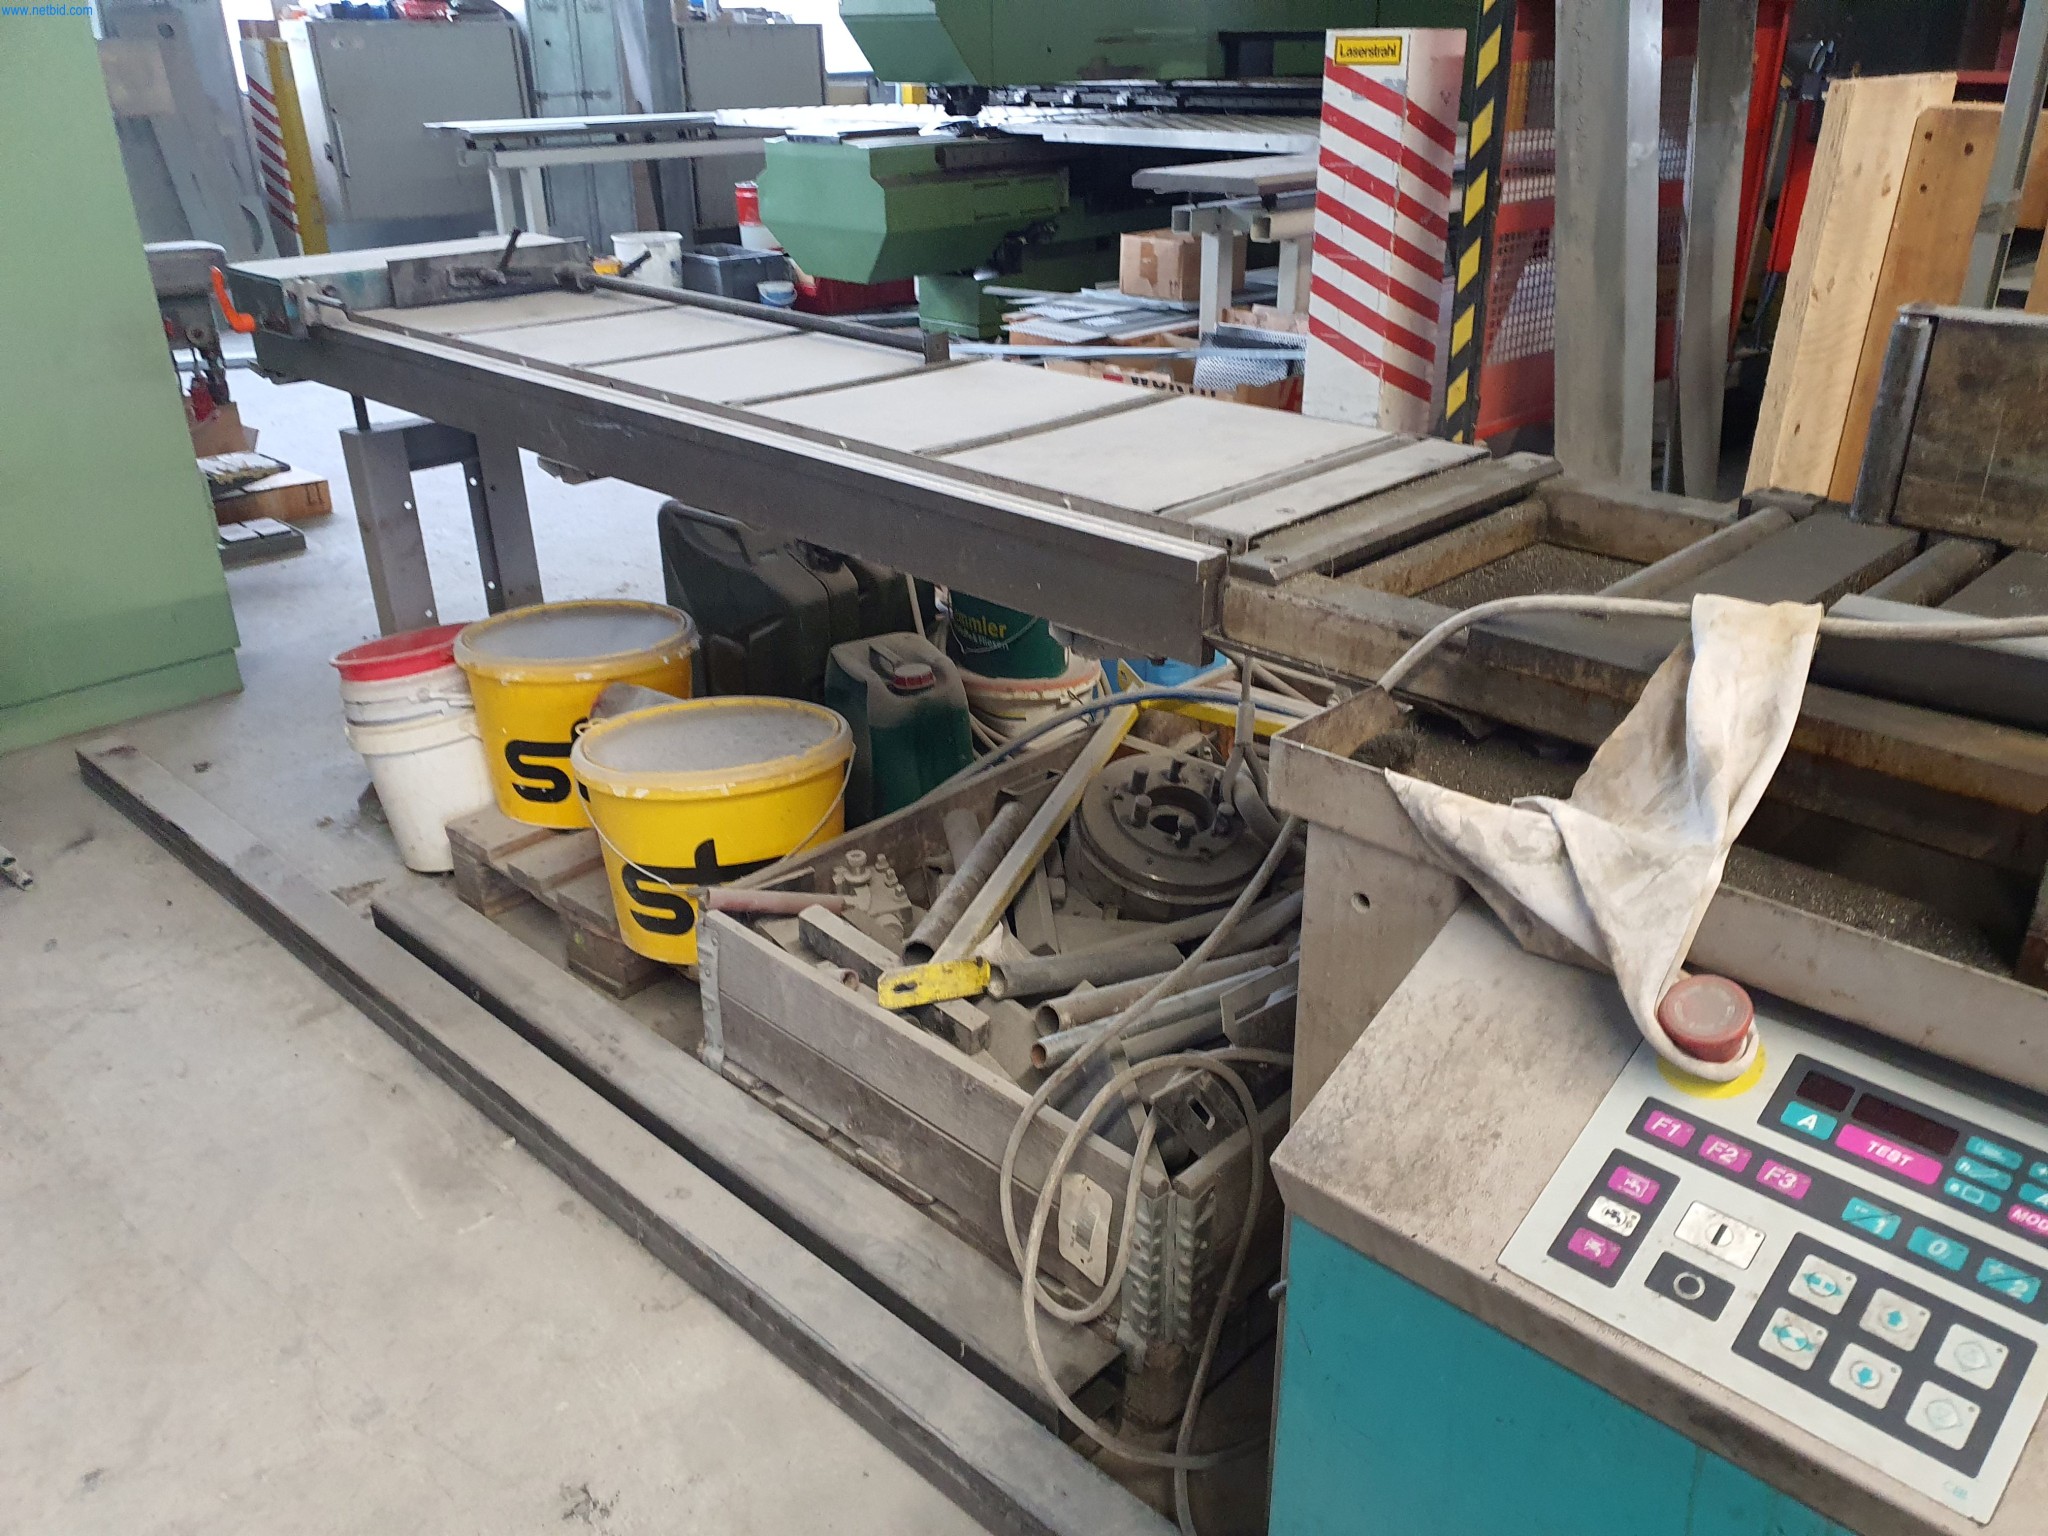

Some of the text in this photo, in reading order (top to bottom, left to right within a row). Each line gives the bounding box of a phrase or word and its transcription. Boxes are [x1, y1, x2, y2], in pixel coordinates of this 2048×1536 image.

[1340, 43, 1397, 58] Laserstrahl
[1651, 1116, 1682, 1138] F1
[1797, 1113, 1818, 1131] A
[1706, 1140, 1739, 1165] F2
[1866, 1140, 1915, 1167] TEST
[1763, 1165, 1798, 1189] F3
[1873, 1217, 1886, 1234] 1
[2006, 1279, 2029, 1299] 2
